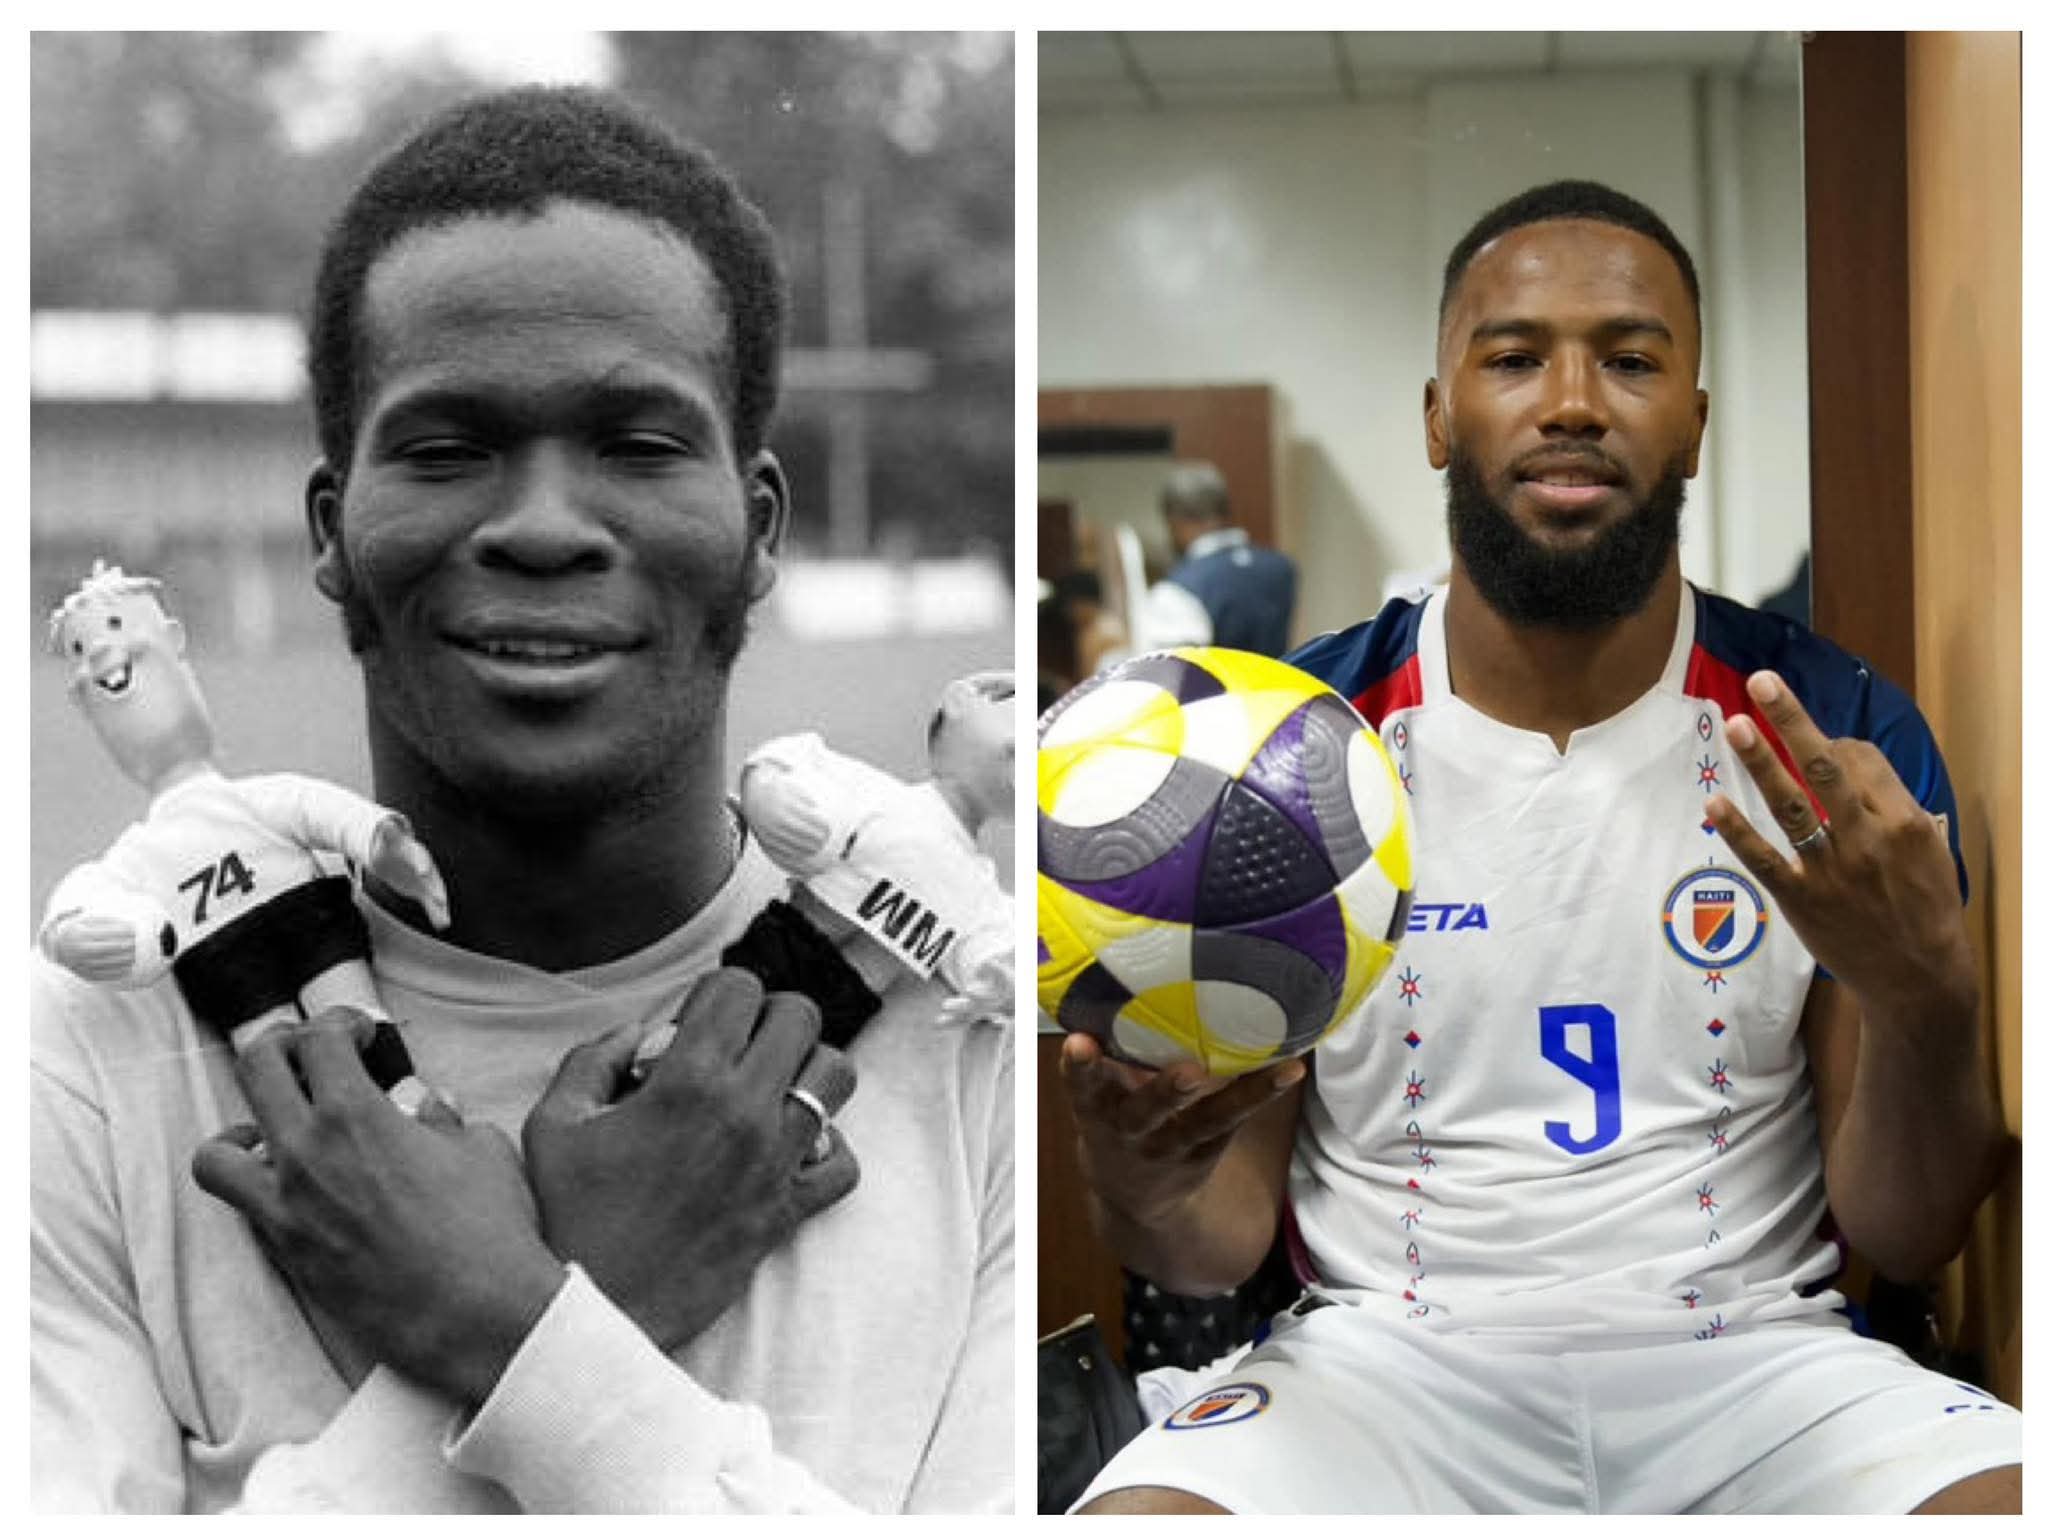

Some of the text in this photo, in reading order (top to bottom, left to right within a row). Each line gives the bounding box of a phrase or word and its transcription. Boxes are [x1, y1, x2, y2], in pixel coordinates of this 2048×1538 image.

[177, 851, 255, 925] 74
[856, 878, 955, 968] WM
[1697, 890, 1731, 901] HAITI
[1539, 1003, 1622, 1156] 9
